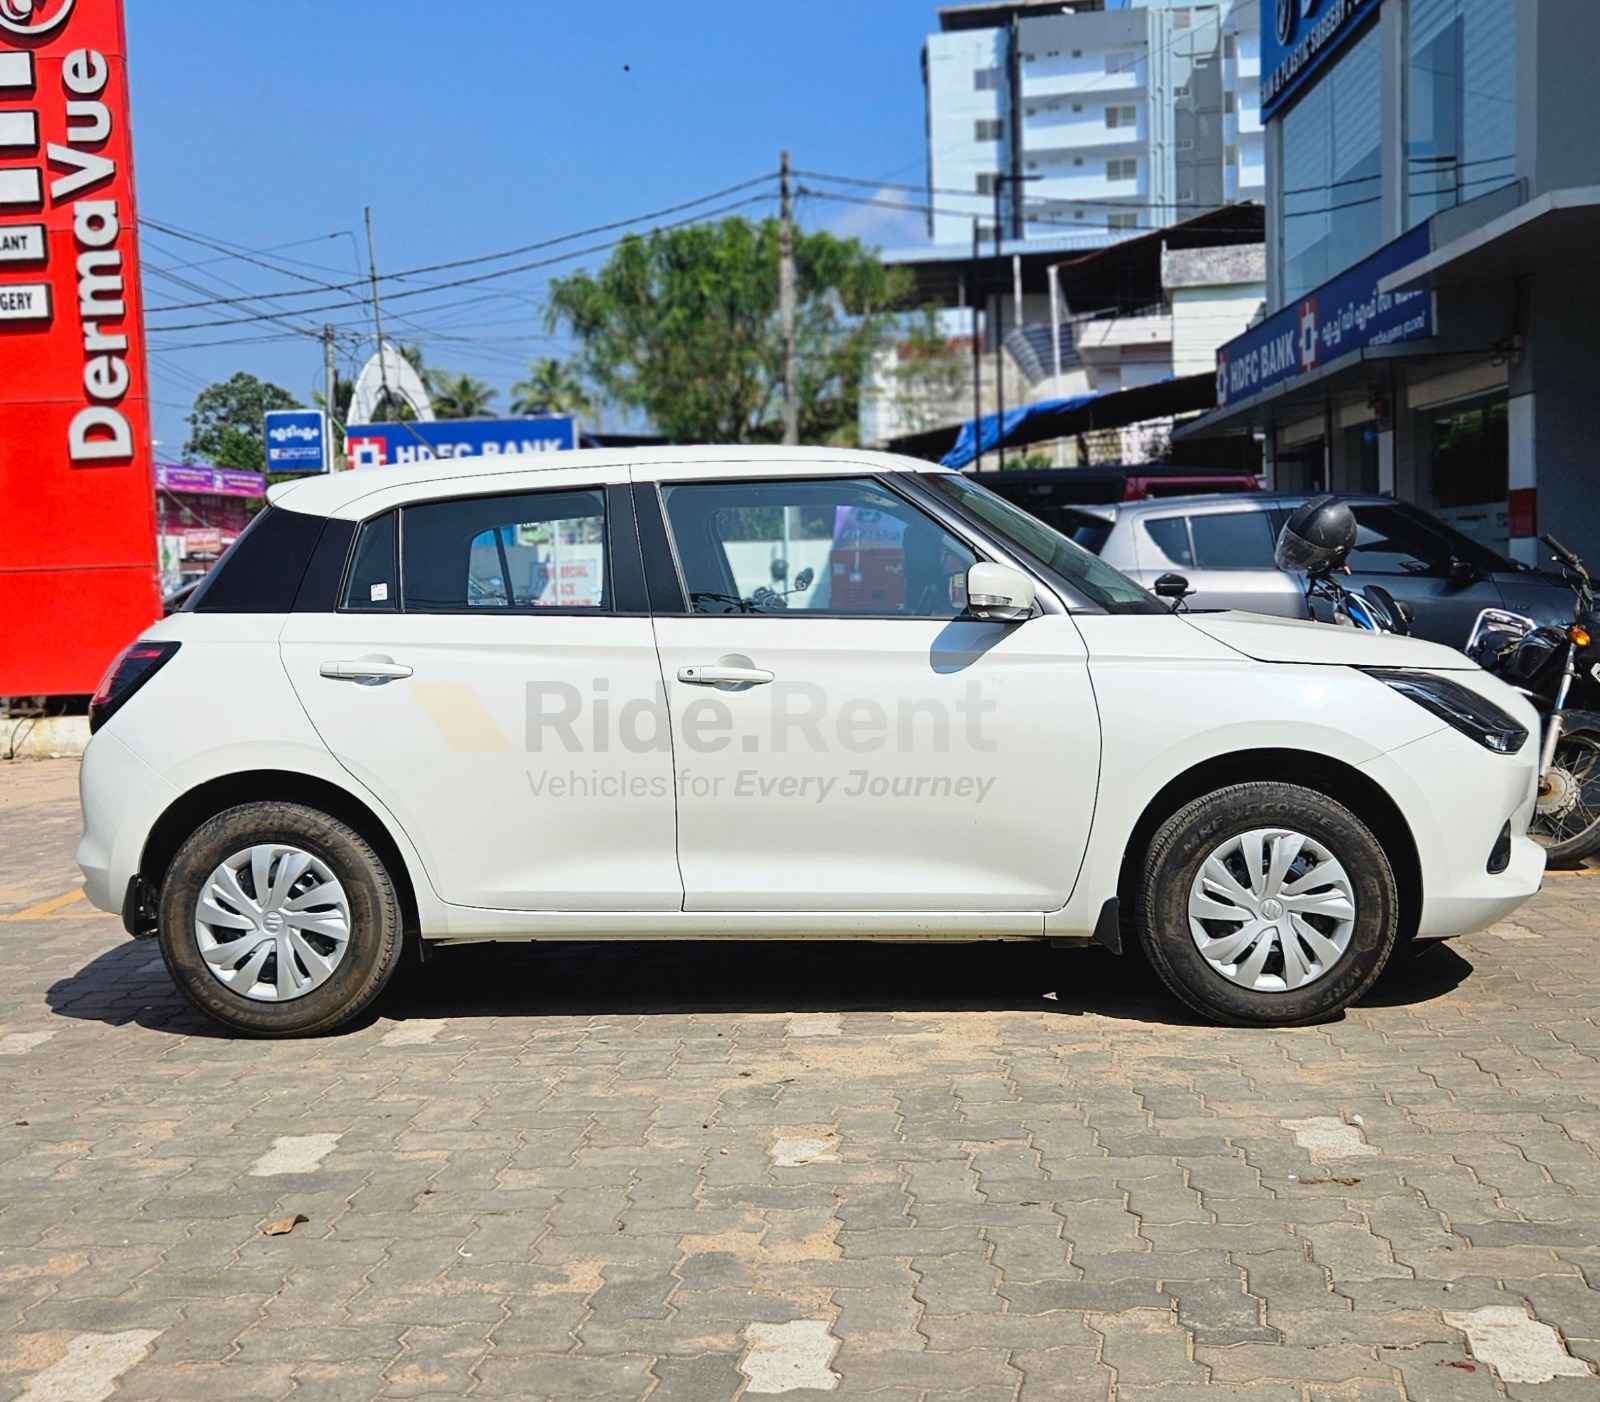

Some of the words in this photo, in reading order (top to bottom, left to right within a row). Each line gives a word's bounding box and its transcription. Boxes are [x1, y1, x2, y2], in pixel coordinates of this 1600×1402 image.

[44, 48, 134, 460] DermaVue
[1231, 349, 1259, 393] HDFC
[1261, 329, 1295, 379] BANK
[396, 443, 474, 464] HDFC
